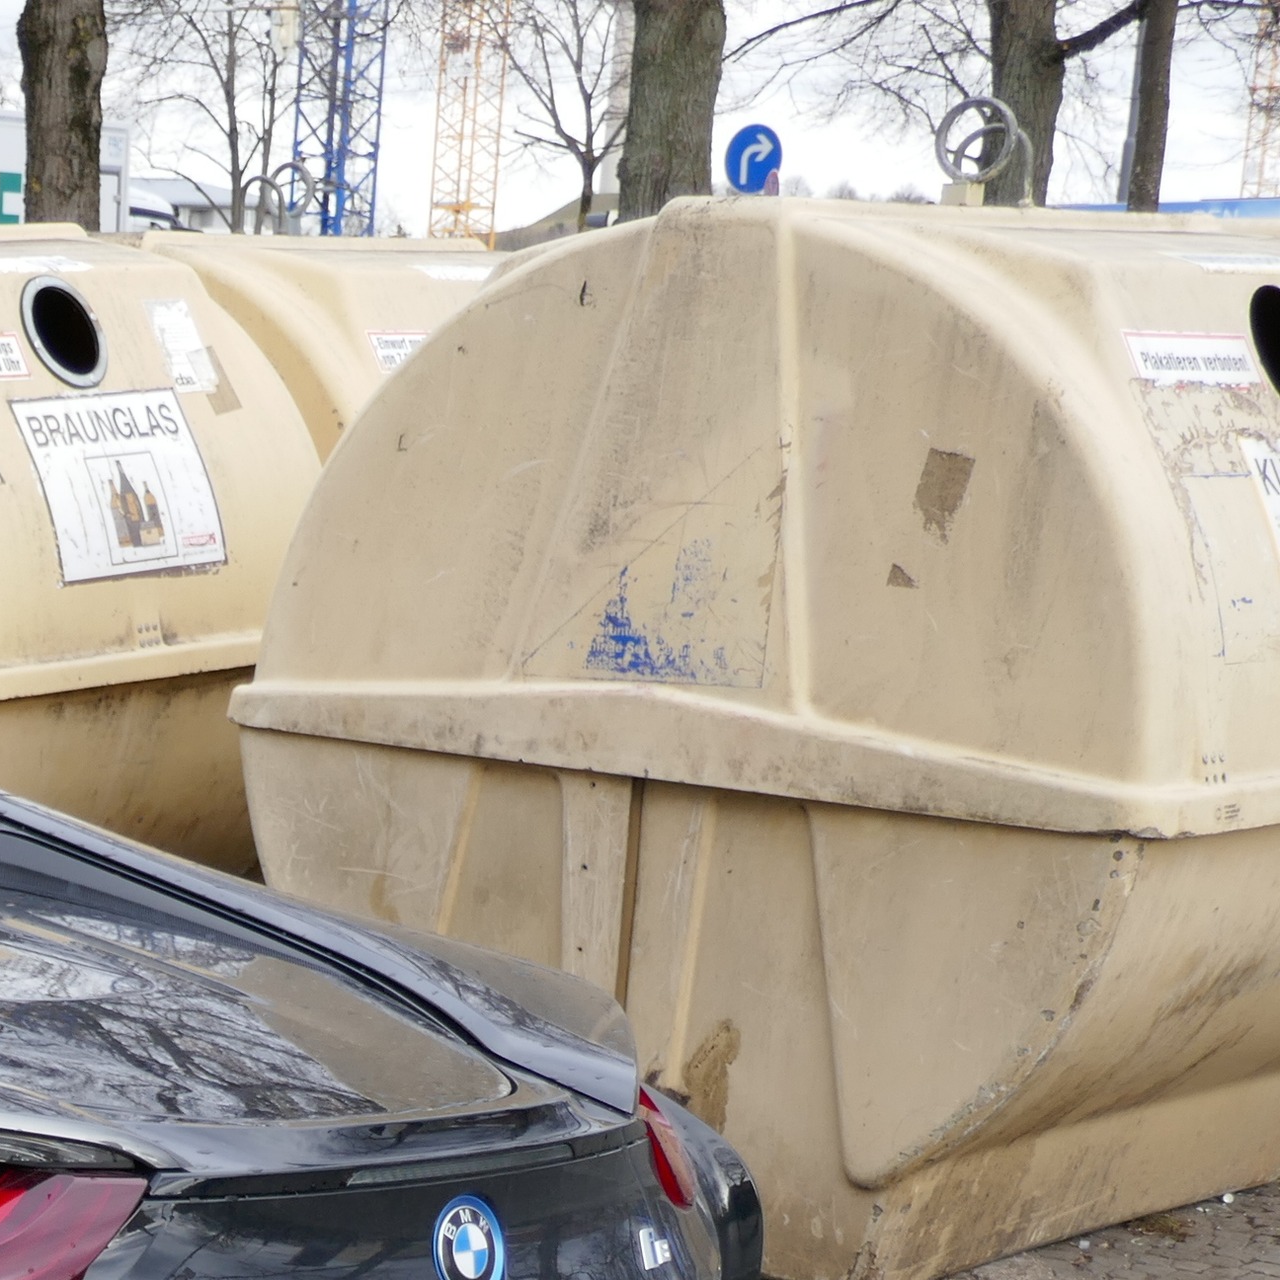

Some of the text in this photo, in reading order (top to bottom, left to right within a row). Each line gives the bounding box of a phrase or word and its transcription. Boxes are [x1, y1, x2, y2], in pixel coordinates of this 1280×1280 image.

[3, 357, 22, 372] Uhr
[1140, 351, 1251, 372] Plakatieren verboten!
[24, 402, 179, 449] BRAUNGLAS
[444, 1208, 490, 1241] BMW
